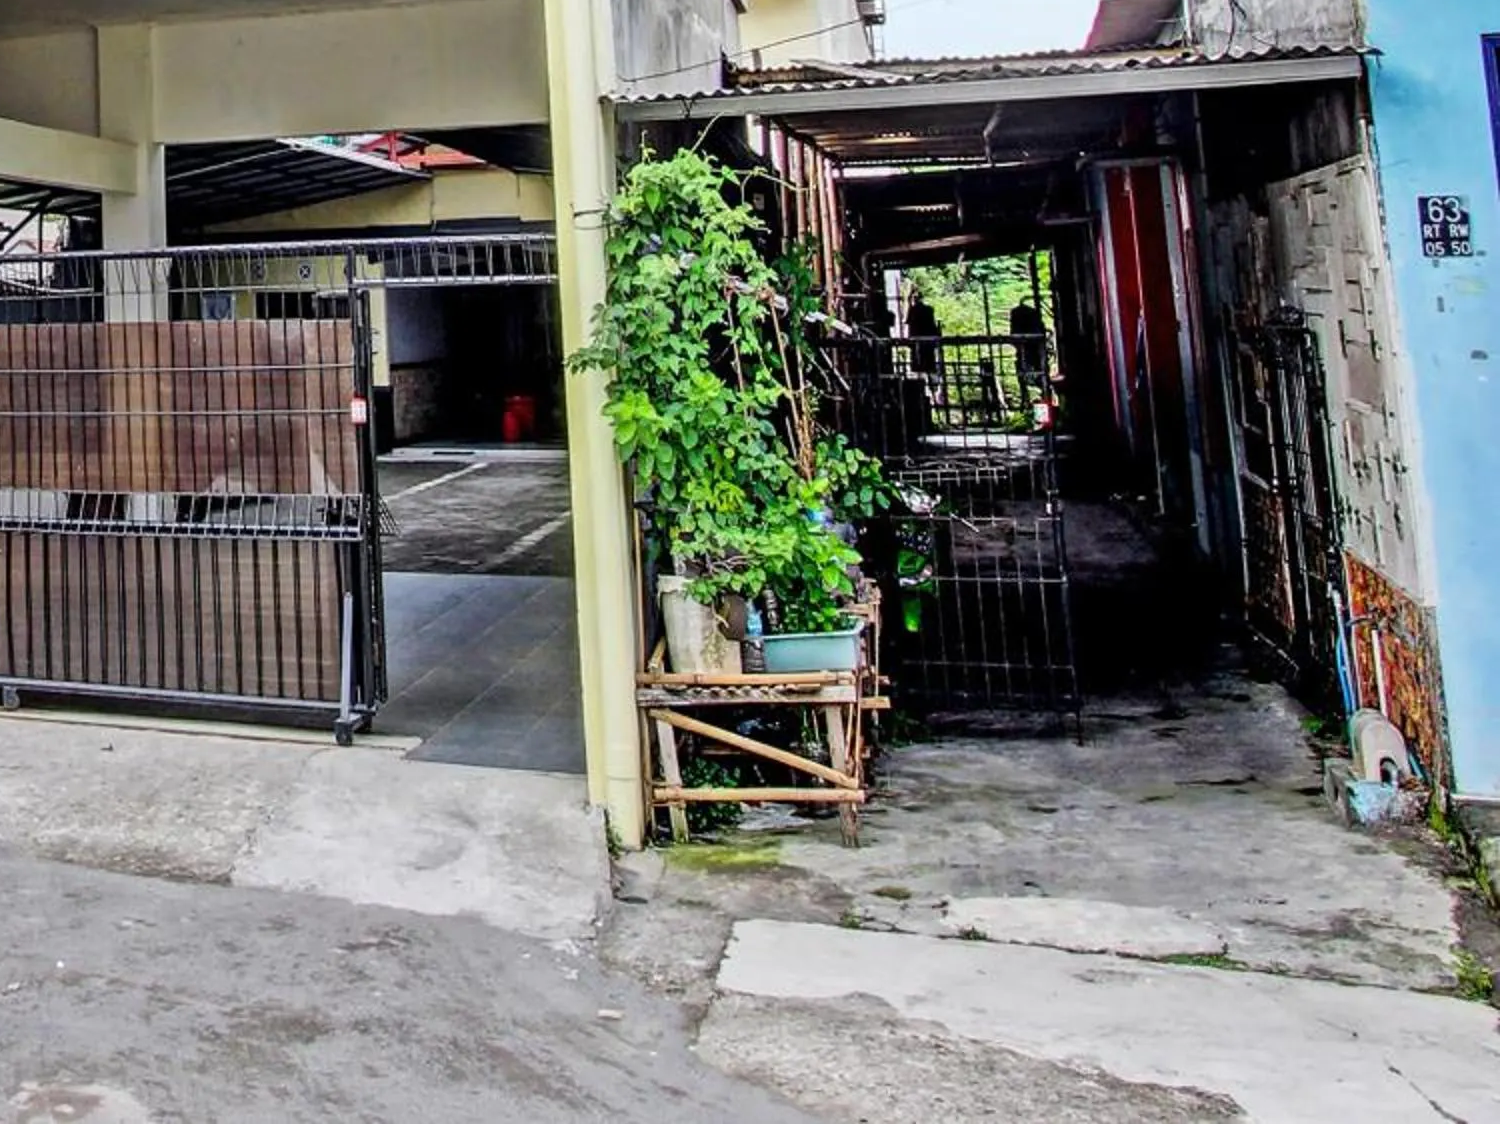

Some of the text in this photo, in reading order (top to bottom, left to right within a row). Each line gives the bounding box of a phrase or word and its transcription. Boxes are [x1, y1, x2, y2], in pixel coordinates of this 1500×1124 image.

[1427, 197, 1461, 223] 63
[1423, 224, 1469, 238] RT RW
[1425, 241, 1471, 256] 05 50
